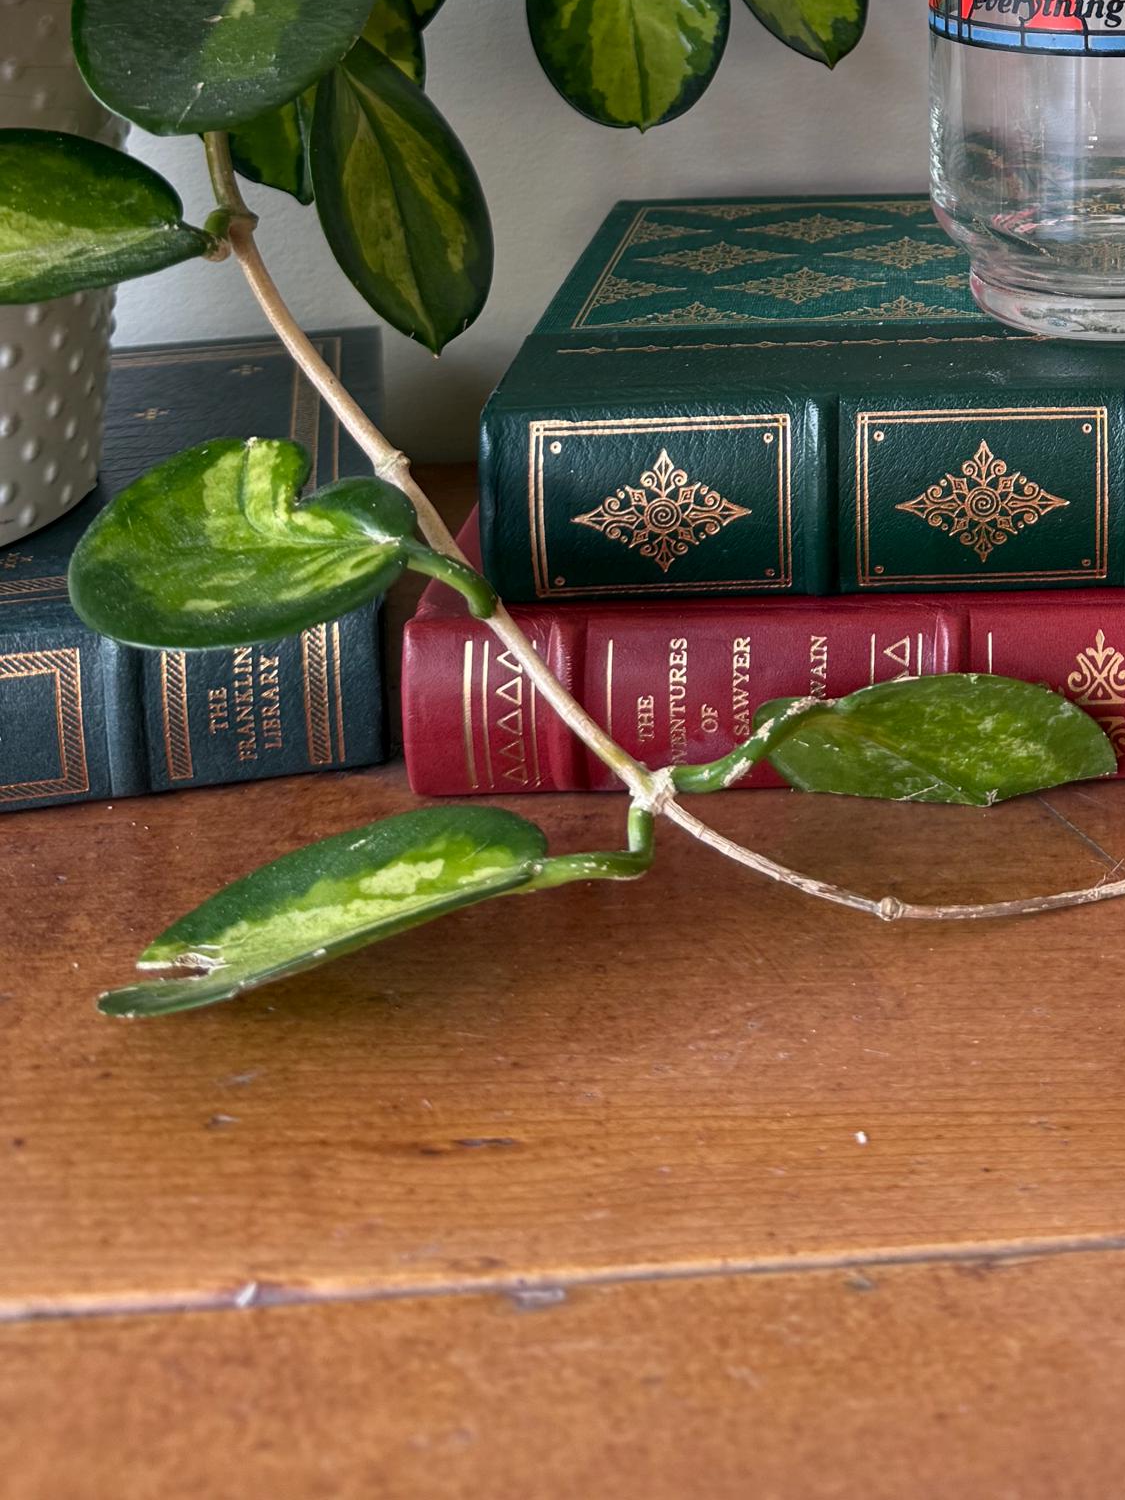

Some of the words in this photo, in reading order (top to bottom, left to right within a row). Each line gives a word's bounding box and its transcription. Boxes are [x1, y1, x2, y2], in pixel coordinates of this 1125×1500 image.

[233, 646, 257, 761] FRANKLIN
[259, 655, 283, 749] LIBRARY
[669, 637, 688, 767] VENTURES
[732, 636, 751, 736] SAWYER
[810, 635, 828, 700] WAIN
[208, 687, 229, 734] THE
[637, 695, 655, 743] THE
[700, 703, 719, 734] OF
